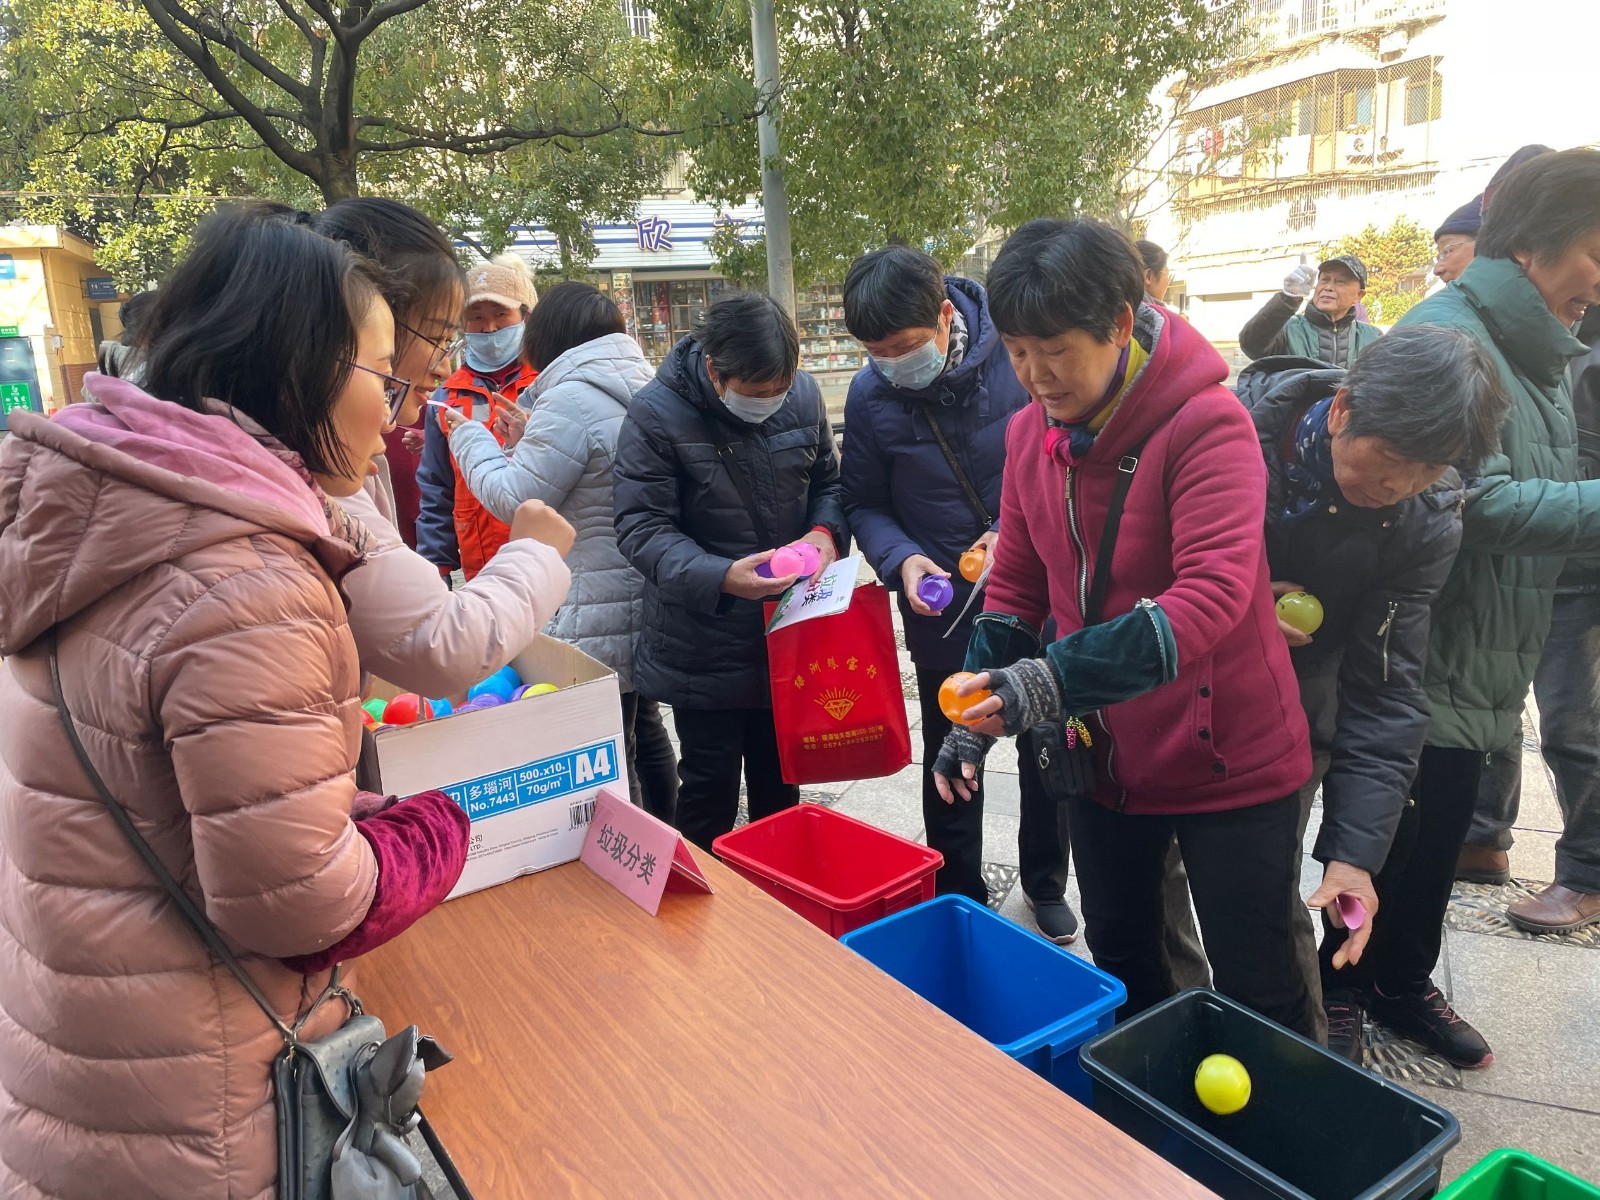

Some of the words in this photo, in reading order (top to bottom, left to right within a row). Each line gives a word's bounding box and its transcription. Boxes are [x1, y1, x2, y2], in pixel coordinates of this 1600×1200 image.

[636, 214, 674, 251] 欣
[575, 747, 611, 784] A4
[469, 776, 513, 801] 多瑙河
[470, 792, 516, 813] No.7443
[597, 823, 657, 886] 垃圾分类
